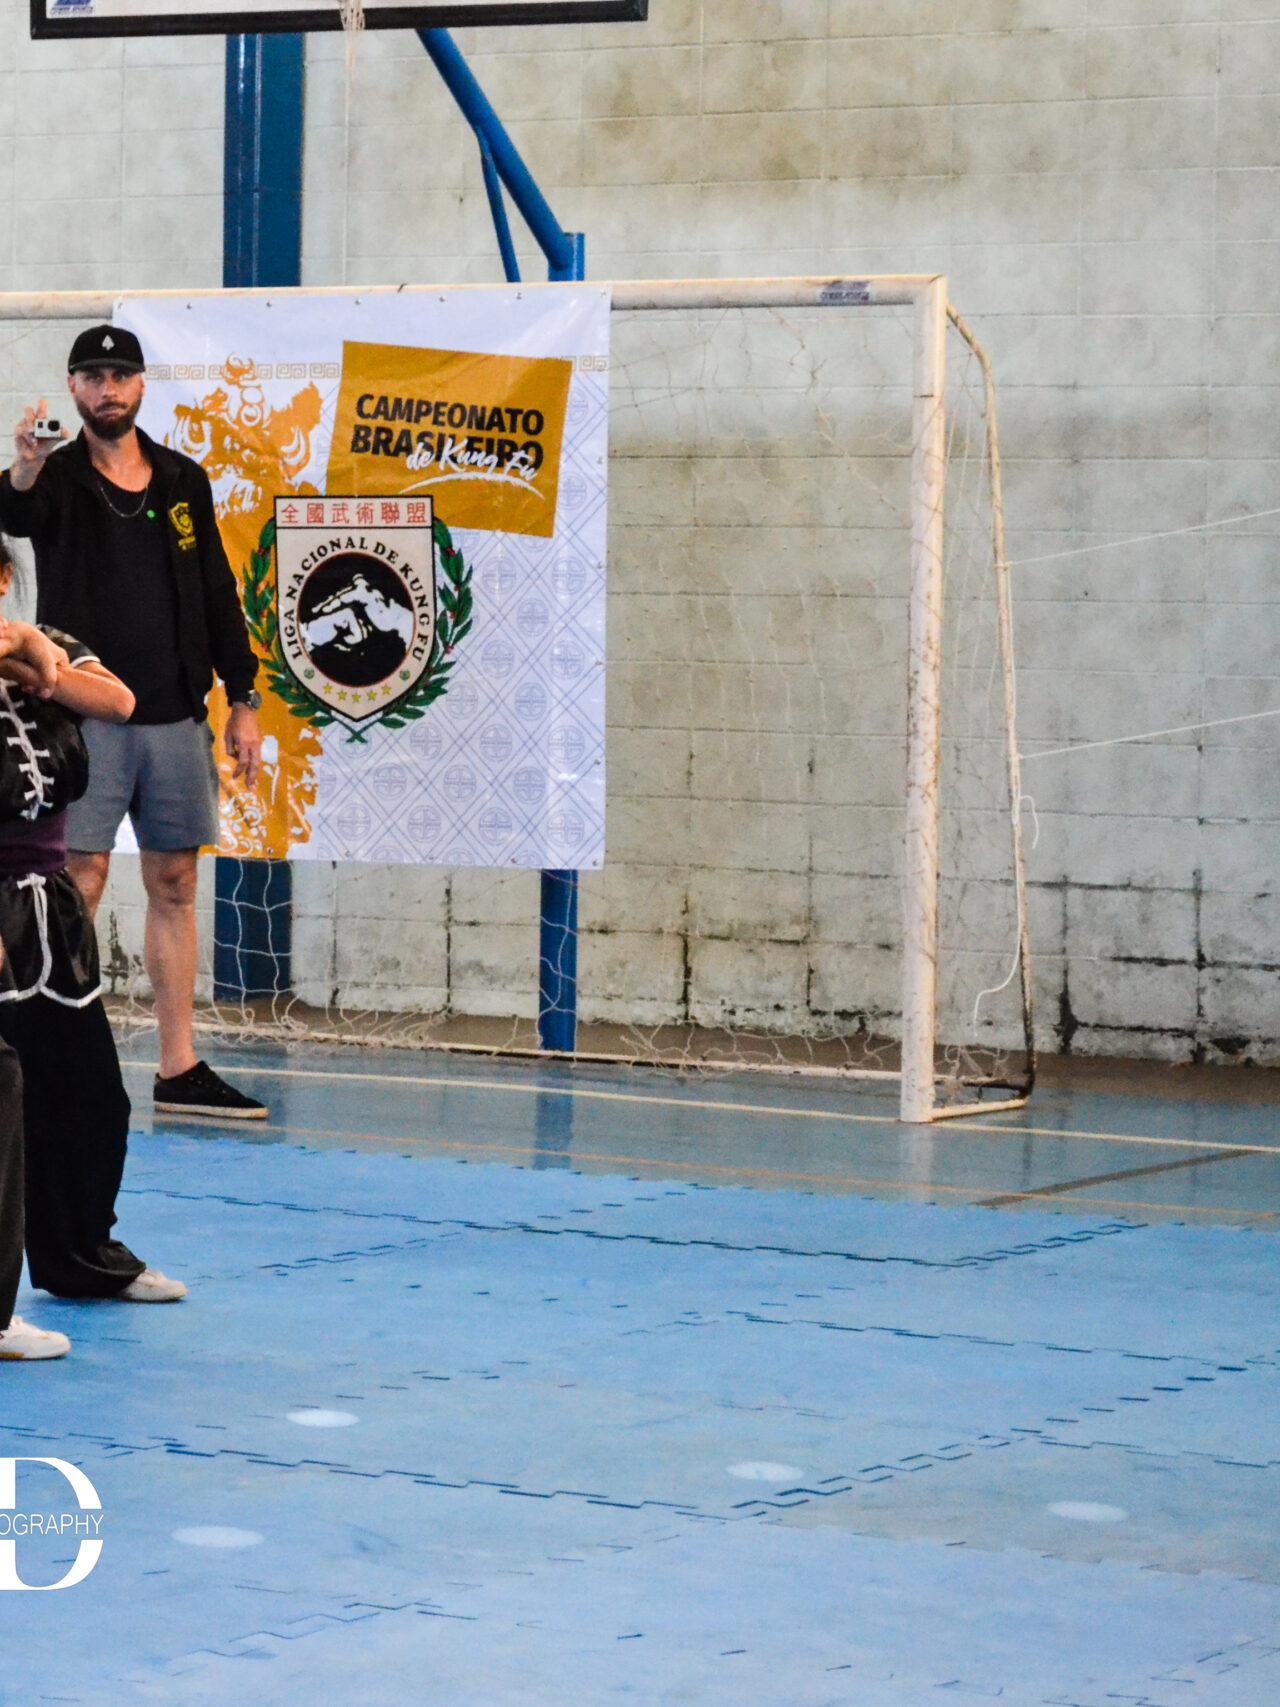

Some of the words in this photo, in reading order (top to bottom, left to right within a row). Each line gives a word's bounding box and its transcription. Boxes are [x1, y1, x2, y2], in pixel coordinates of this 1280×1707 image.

[356, 393, 544, 436] CAMPEONATO
[406, 441, 436, 471] de
[438, 437, 499, 475] Kung
[503, 449, 538, 481] Fu
[281, 501, 426, 524] 全國武術聯盟
[286, 536, 368, 600] NACIONAL
[373, 542, 399, 564] DE
[400, 563, 430, 626] KUNG
[284, 609, 303, 660] LIGA
[412, 635, 429, 662] FU
